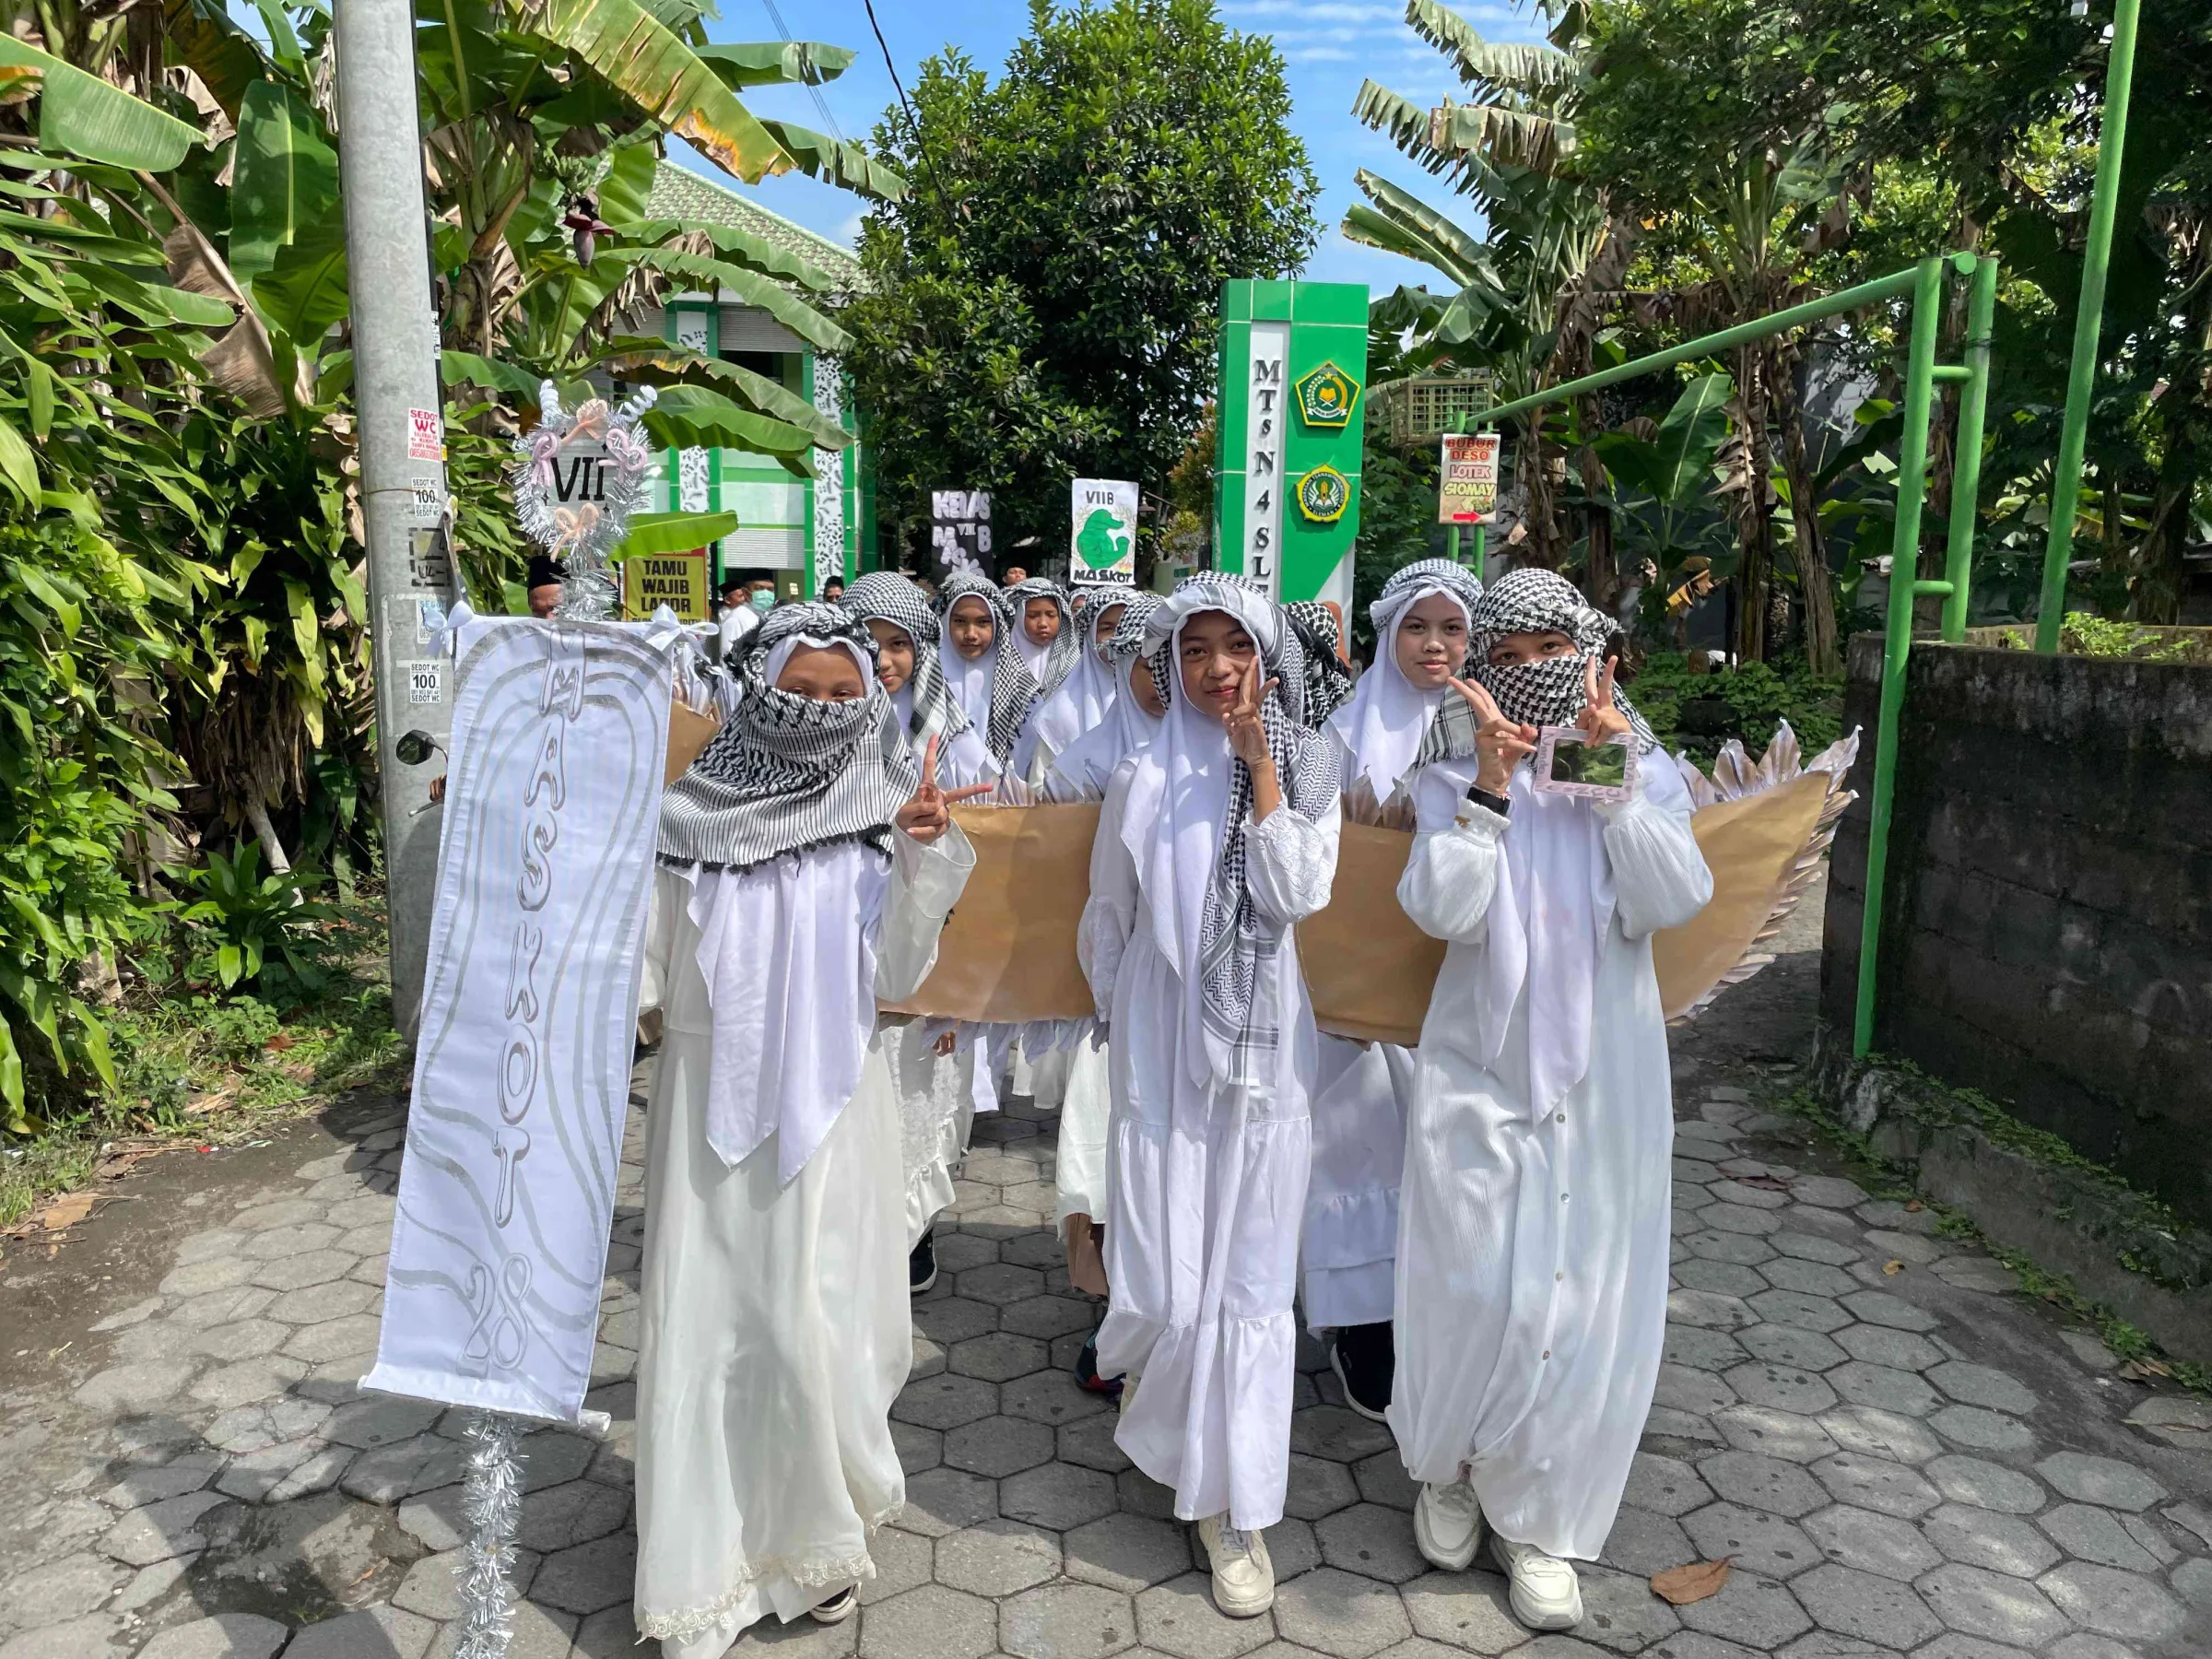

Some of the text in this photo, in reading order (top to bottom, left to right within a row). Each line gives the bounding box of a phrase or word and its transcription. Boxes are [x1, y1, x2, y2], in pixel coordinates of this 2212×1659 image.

[410, 409, 439, 421] SEDOT
[415, 418, 436, 434] WC
[1446, 438, 1497, 450] BUBUR
[1451, 450, 1489, 461] DESO
[550, 457, 608, 501] VII
[1450, 465, 1491, 479] LOTEK
[1443, 482, 1496, 496] SIOMAY
[1086, 490, 1114, 505] VIIB
[932, 490, 991, 520] KELAS
[977, 524, 992, 553] B
[642, 559, 688, 576] TAMU
[1073, 569, 1133, 583] MASKOT
[641, 578, 690, 594] WAJIB
[413, 675, 436, 688] 100
